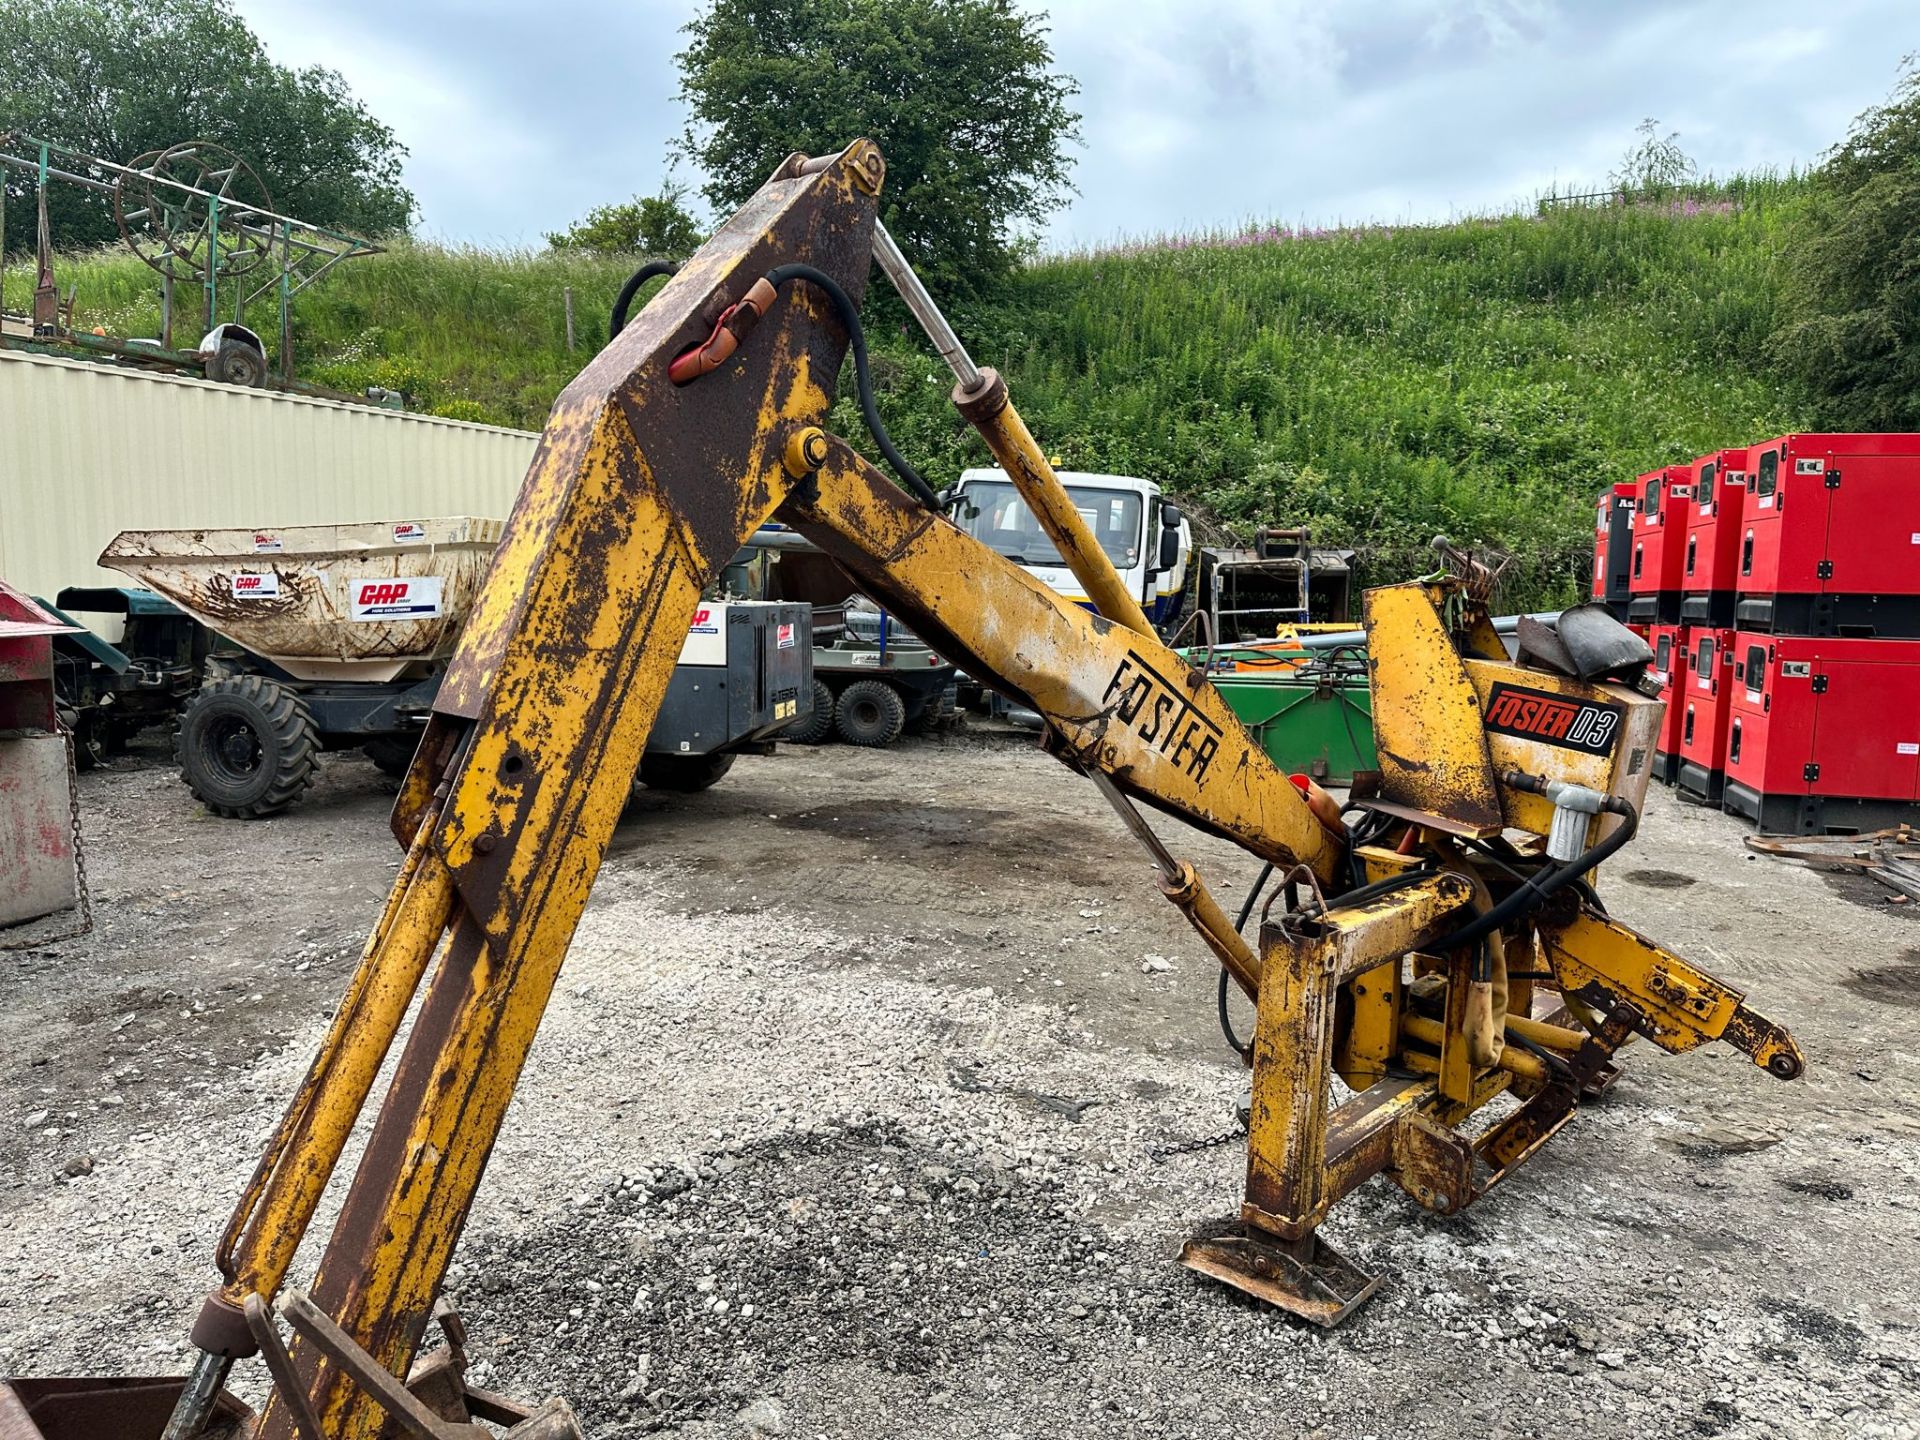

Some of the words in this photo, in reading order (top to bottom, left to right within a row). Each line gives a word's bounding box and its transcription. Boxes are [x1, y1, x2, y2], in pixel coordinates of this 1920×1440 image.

[236, 577, 260, 589] GAP
[358, 584, 408, 605] GAP
[777, 687, 799, 702] TEREX
[1102, 649, 1224, 784] FOSTER
[1486, 690, 1580, 739] FOSTER
[1565, 706, 1619, 748] D3
